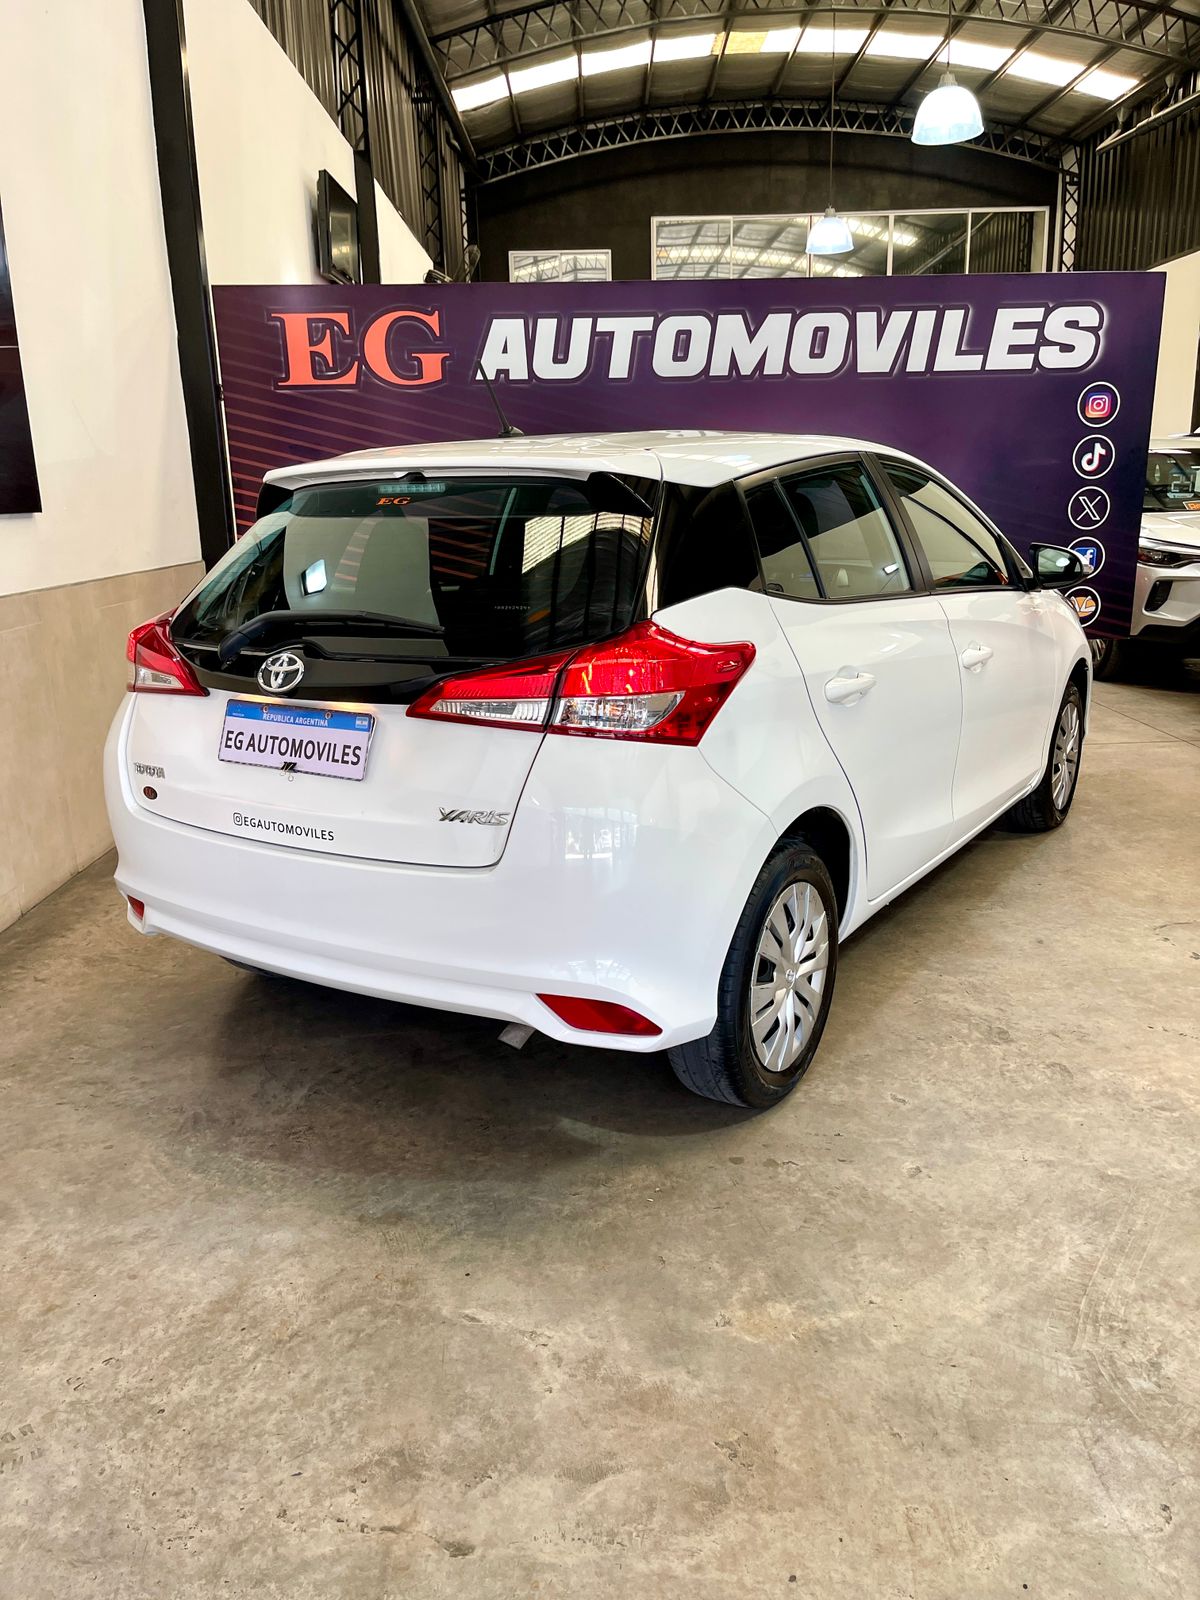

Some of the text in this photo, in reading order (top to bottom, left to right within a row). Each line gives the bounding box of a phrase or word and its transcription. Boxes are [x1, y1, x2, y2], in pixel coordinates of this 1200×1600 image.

[270, 305, 1102, 387] EG AUTOMOVILES
[376, 496, 412, 506] EG
[295, 717, 329, 727] ARGENTINA
[224, 730, 362, 766] EG AUTOMOVILES
[438, 806, 511, 826] YARIS
